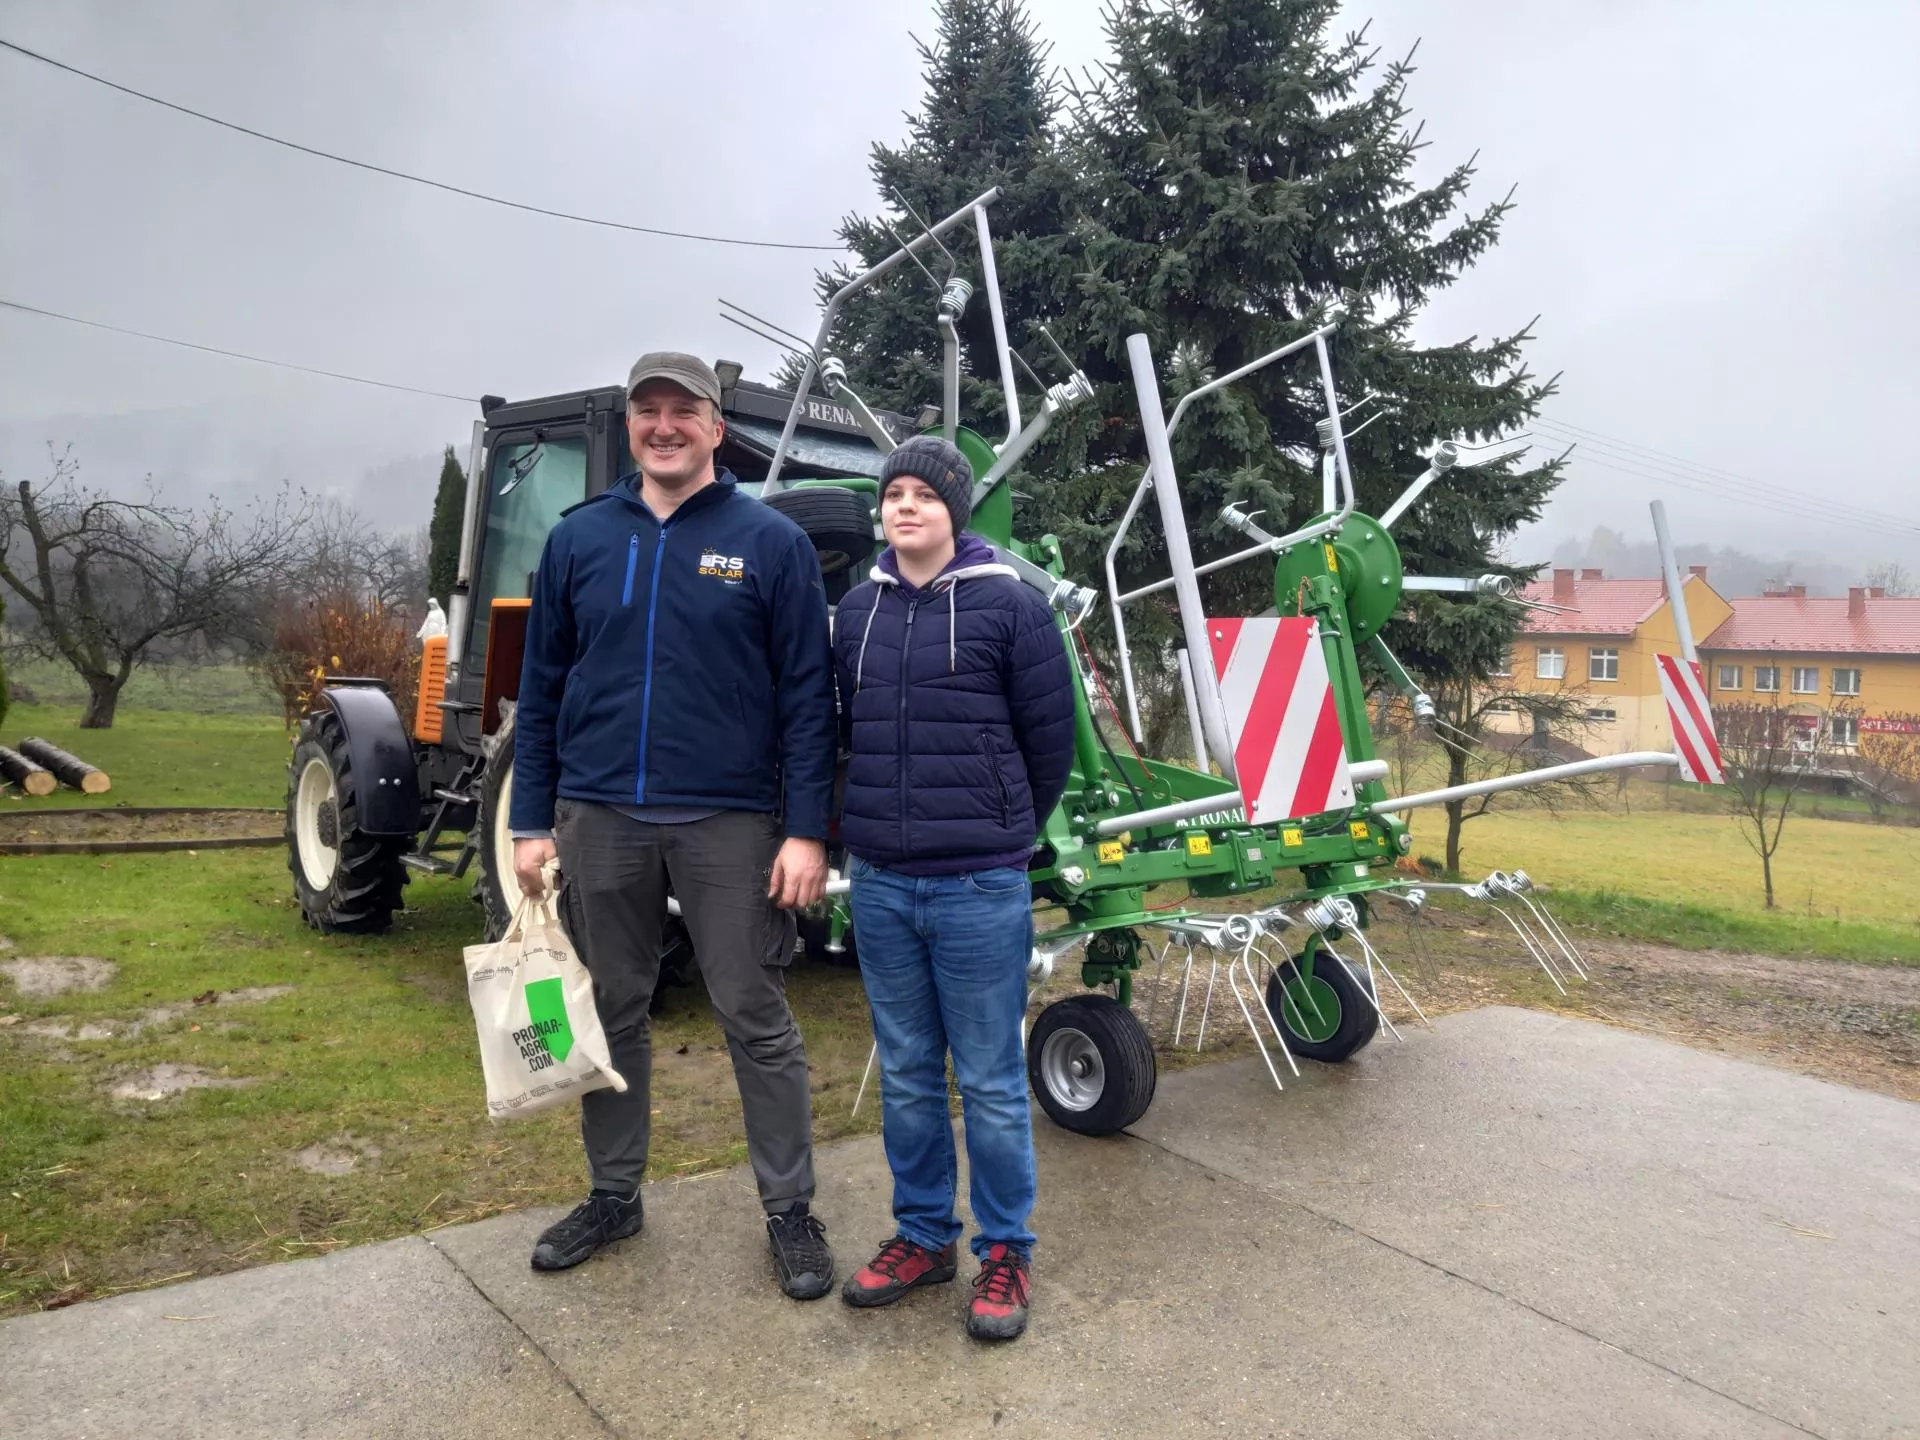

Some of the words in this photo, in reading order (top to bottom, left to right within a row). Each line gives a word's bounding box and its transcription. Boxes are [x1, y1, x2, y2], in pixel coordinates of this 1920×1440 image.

[808, 401, 886, 429] RENAT
[698, 567, 743, 578] SOLAR
[512, 1018, 563, 1046] PRONAR-
[520, 1037, 549, 1060] AGRO
[529, 1052, 554, 1073] .COM
